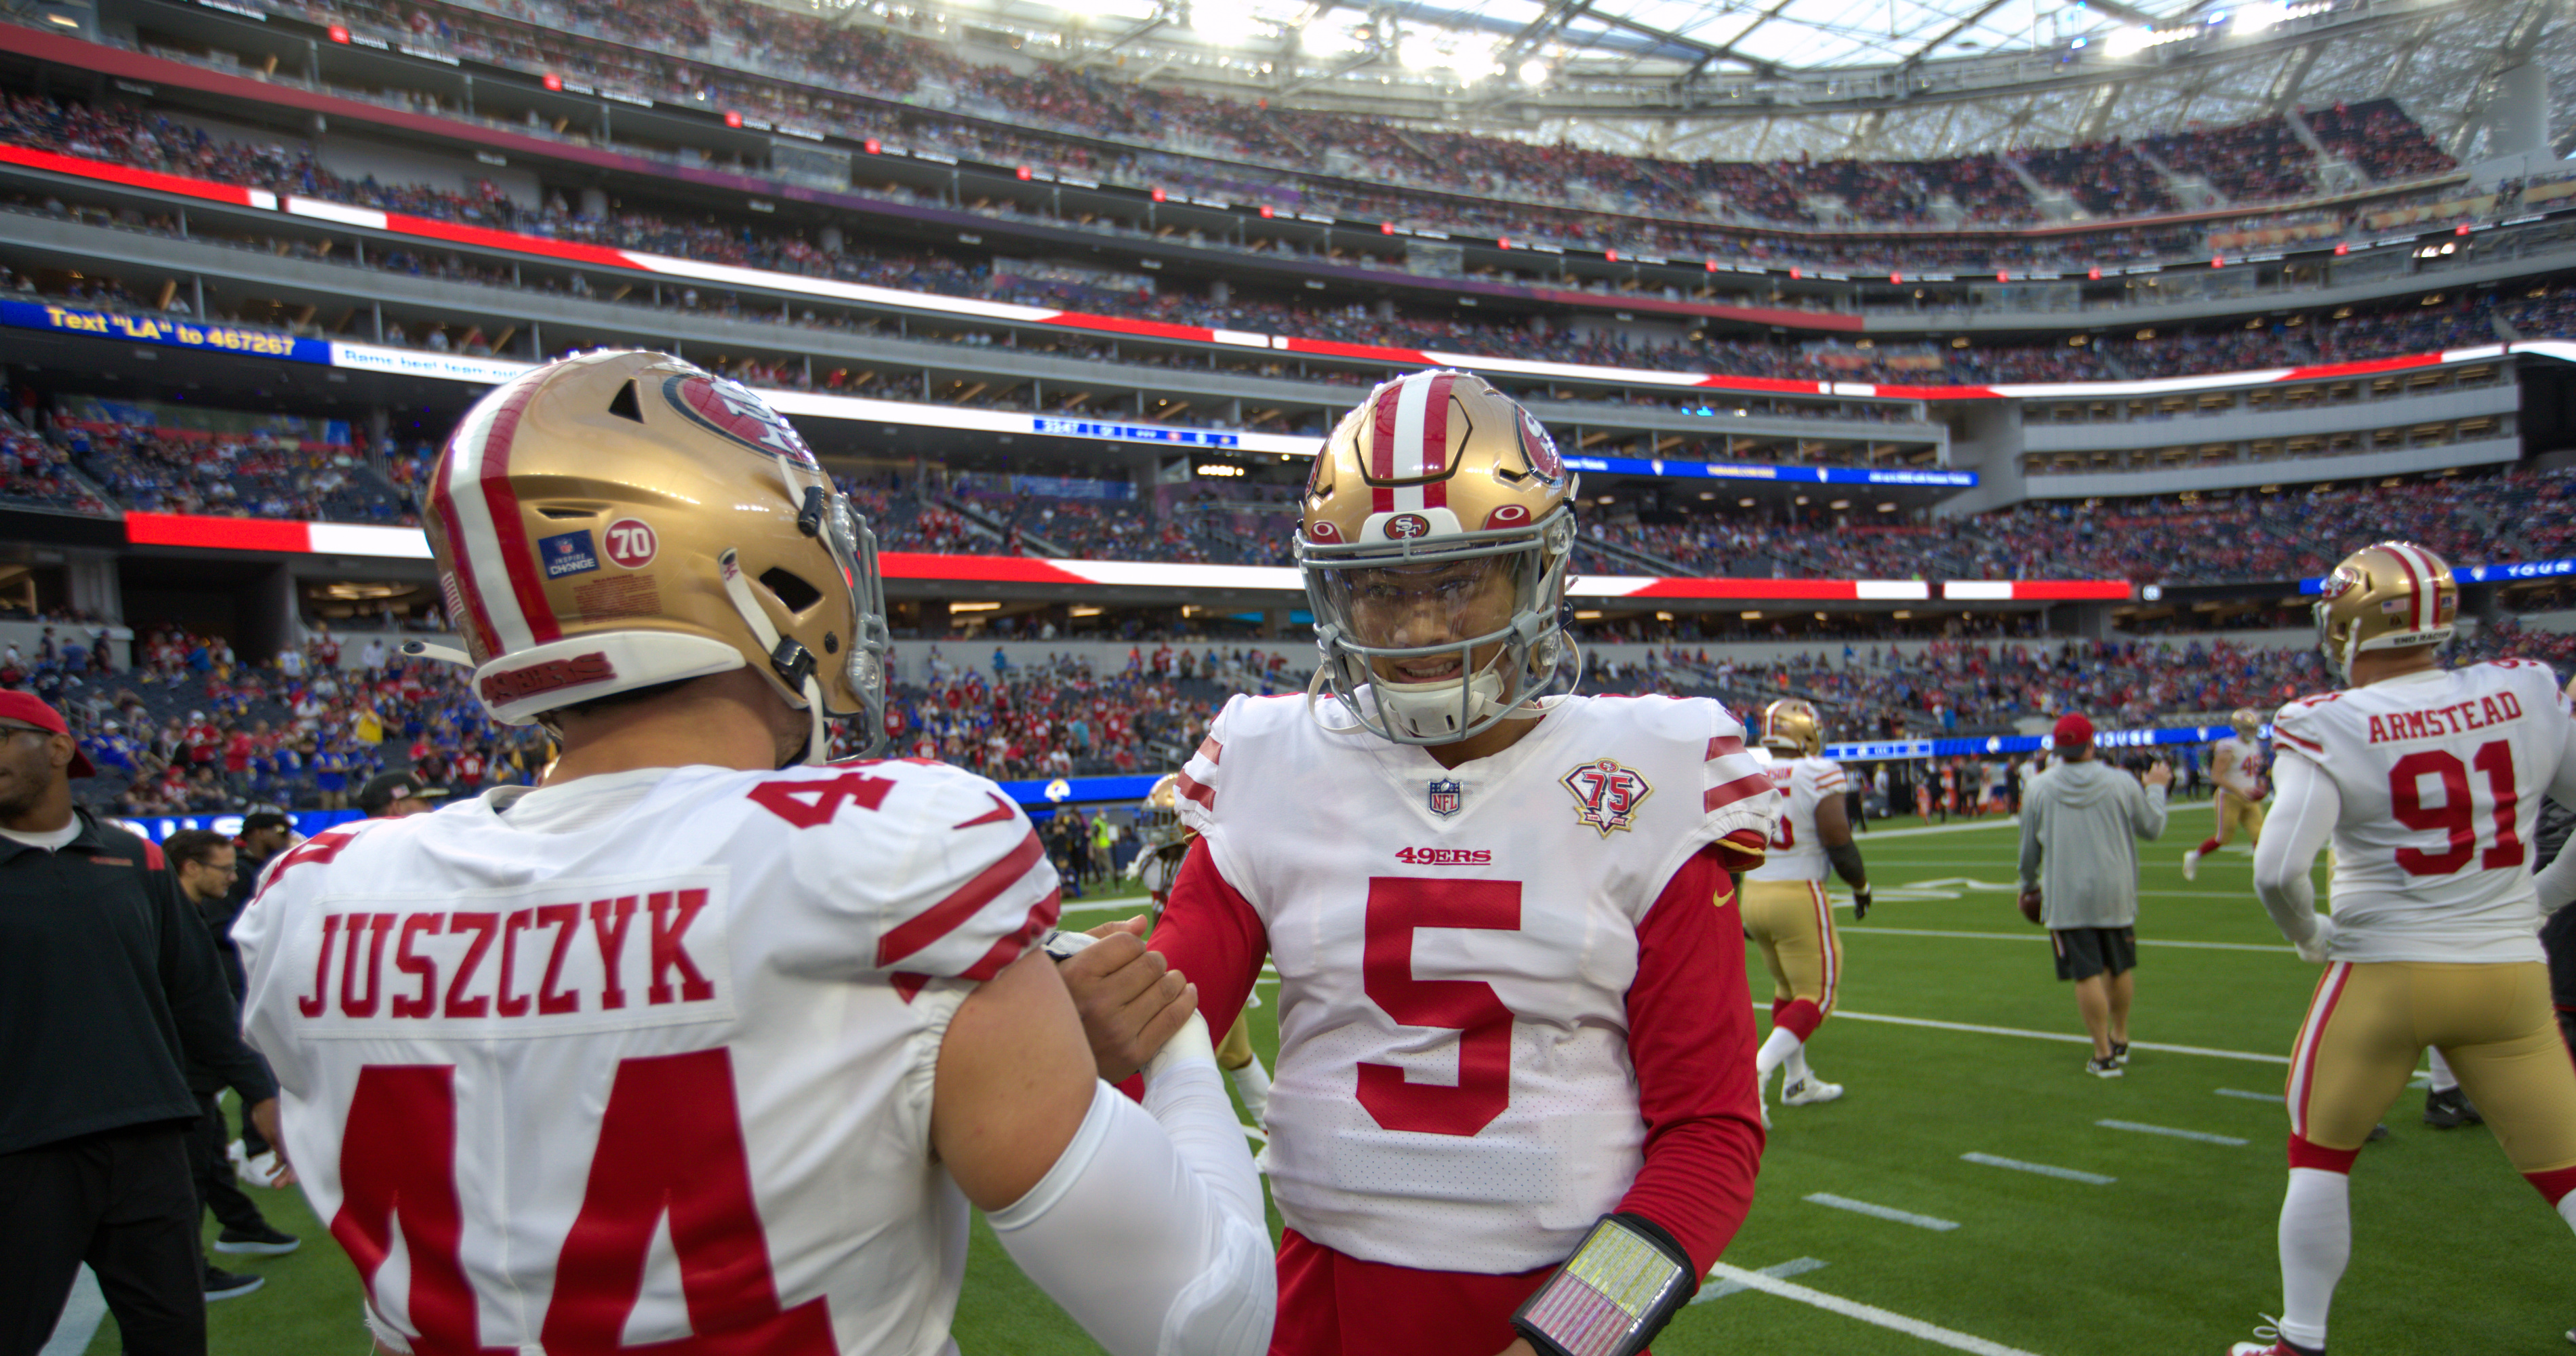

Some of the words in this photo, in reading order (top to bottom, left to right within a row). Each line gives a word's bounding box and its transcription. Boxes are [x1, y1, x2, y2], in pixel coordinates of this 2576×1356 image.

[46, 305, 108, 333] Text
[110, 312, 174, 340] "LA"
[176, 323, 204, 346] to
[206, 327, 296, 357] 467267
[555, 553, 586, 565] INSPIRE
[611, 528, 651, 559] 70
[2507, 559, 2573, 577] YOUR
[2369, 691, 2522, 744] ARMSTEAD
[1432, 794, 1457, 812] NFL
[1582, 772, 1633, 814] 75
[2388, 739, 2525, 876] 91
[1395, 846, 1491, 865] 49ERS
[299, 888, 715, 1018] JUSZCZYK
[1356, 877, 1523, 1137] 5
[331, 1046, 841, 1356] 44
